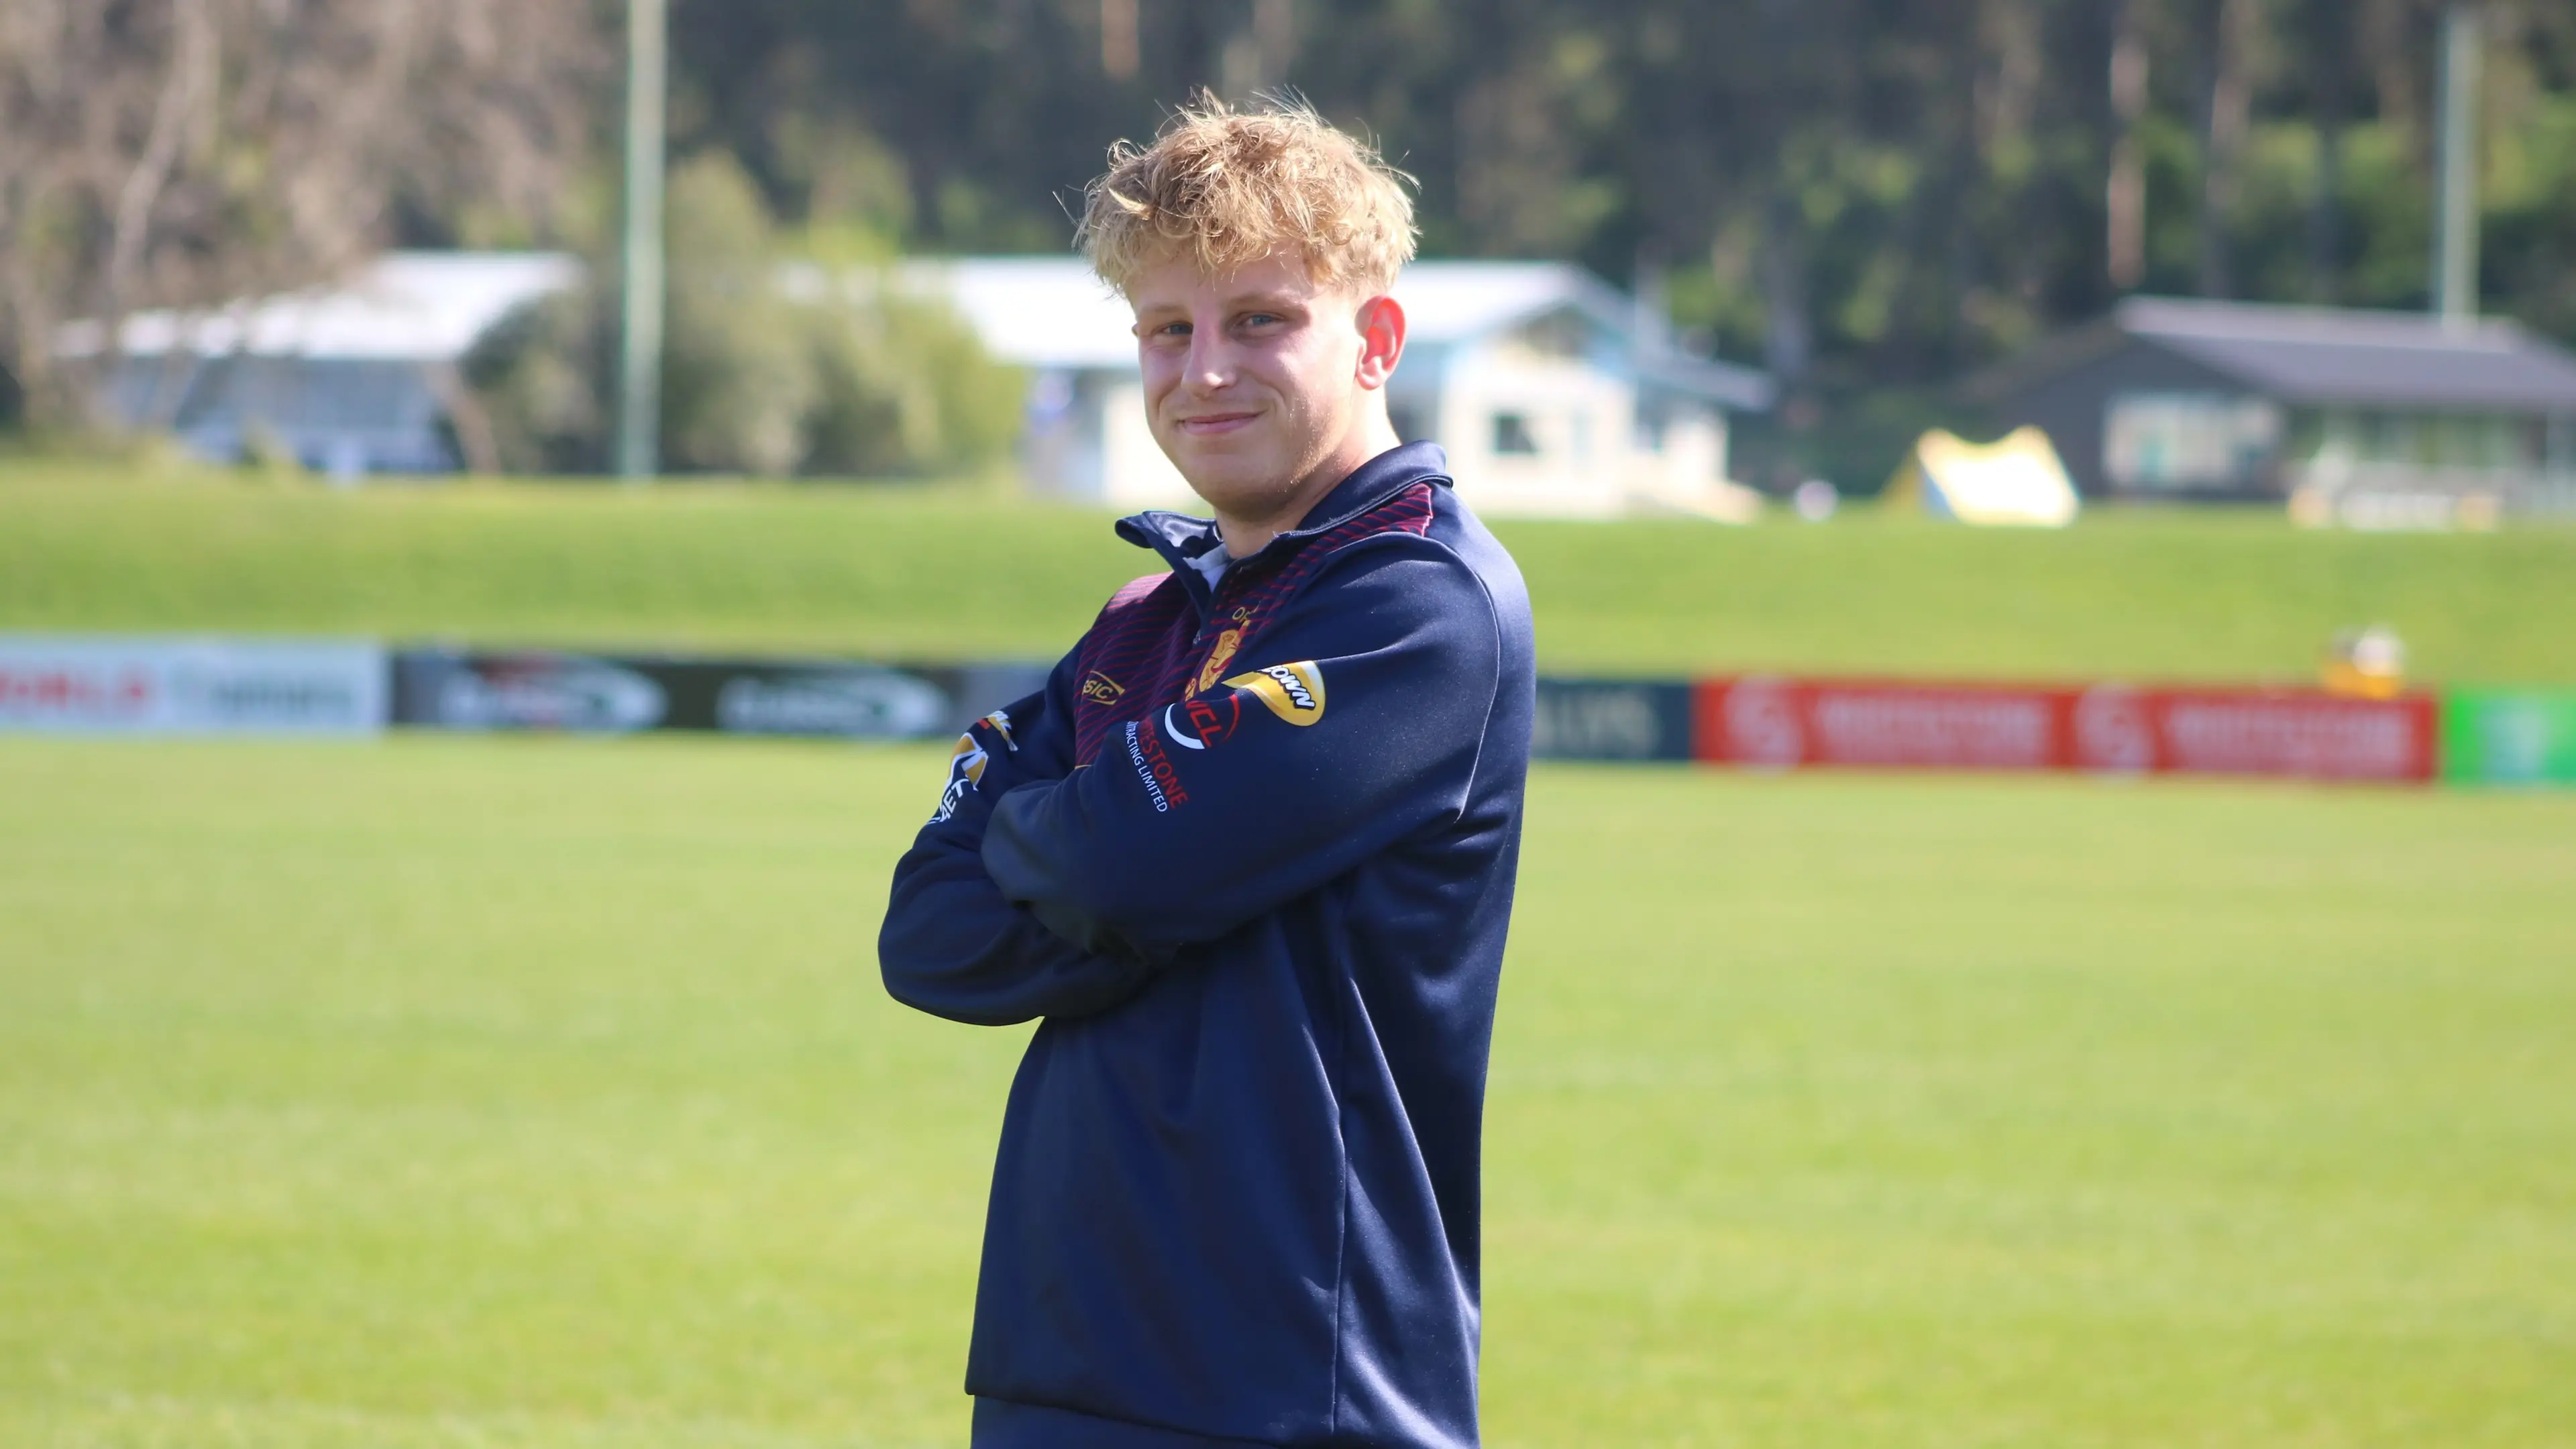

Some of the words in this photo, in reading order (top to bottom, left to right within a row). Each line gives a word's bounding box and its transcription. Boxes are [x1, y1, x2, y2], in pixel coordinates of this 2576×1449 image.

[1082, 679, 1113, 699] SIC
[1256, 665, 1316, 710] OWN
[1138, 765, 1167, 812] LIMITED
